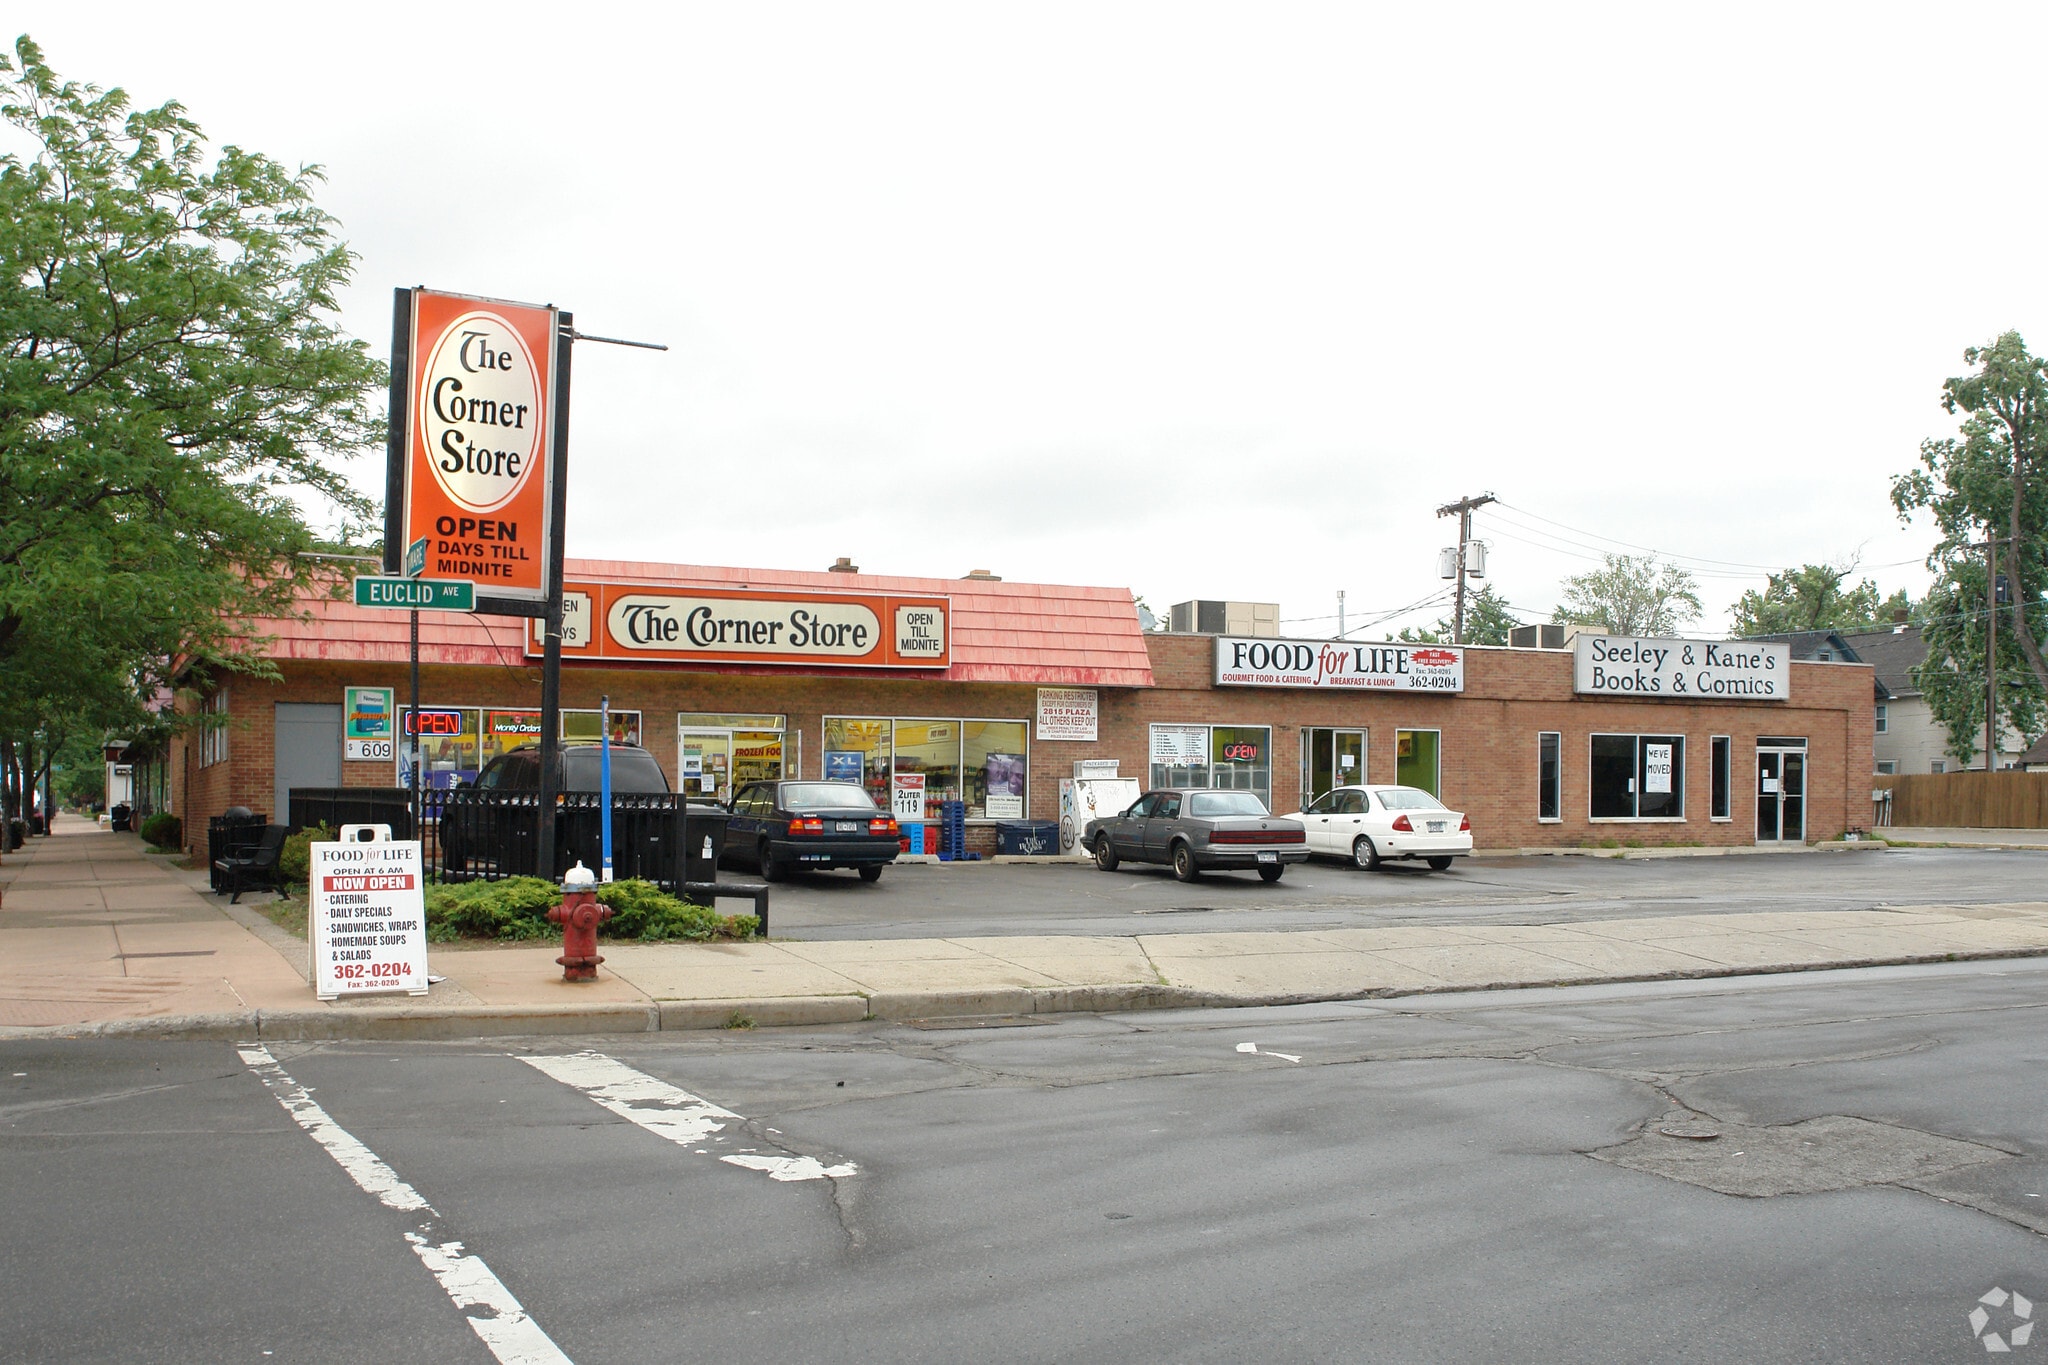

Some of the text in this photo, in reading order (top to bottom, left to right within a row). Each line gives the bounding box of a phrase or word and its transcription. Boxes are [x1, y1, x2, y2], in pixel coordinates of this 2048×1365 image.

[460, 331, 513, 373] The
[433, 376, 528, 429] Corner
[440, 429, 521, 478] Store
[435, 516, 517, 542] OPEN
[438, 541, 484, 557] DAYS
[490, 545, 529, 561] TILL
[437, 559, 513, 578] MIDNITE
[370, 583, 459, 604] EUCLID AVE
[563, 600, 578, 612] EN
[621, 604, 868, 649] The Corner Store
[906, 613, 934, 626] OPEN
[561, 627, 577, 640] YS
[909, 625, 931, 639] TILL
[900, 637, 940, 652] MIDNITE
[1591, 638, 1776, 673] Seeley & Kane's
[1231, 642, 1410, 686] FOOD for LIFE
[1222, 673, 1312, 685] GOURMET FOOD & CATERING
[1330, 676, 1396, 687] BREAKFAST & LUNCH
[1408, 675, 1457, 689] 362-0204
[1591, 667, 1775, 696] Books & Comics
[1038, 690, 1063, 700] PARKING
[1065, 708, 1091, 716] PLAZA
[494, 723, 519, 732] Money
[1039, 715, 1096, 726] ALL OTHERS KEEP OUT
[734, 747, 782, 757] FROZEN FOO
[1224, 744, 1257, 759] OPEN
[1647, 764, 1672, 775] MOVED
[322, 847, 413, 865] FOOD for LIFE
[333, 867, 361, 876] OPEN
[364, 867, 376, 875] AT
[332, 876, 406, 891] NOW OPEN
[330, 894, 369, 905] CATERING
[330, 906, 393, 919] DAILY SPECIALS
[330, 920, 418, 934] SANDWICHES, WRAPS
[331, 935, 407, 948] HOMEMADE SOUPS
[332, 949, 372, 961] & SALADS
[334, 962, 412, 979] 362-0204
[347, 979, 400, 989] Fax: 362-0205
